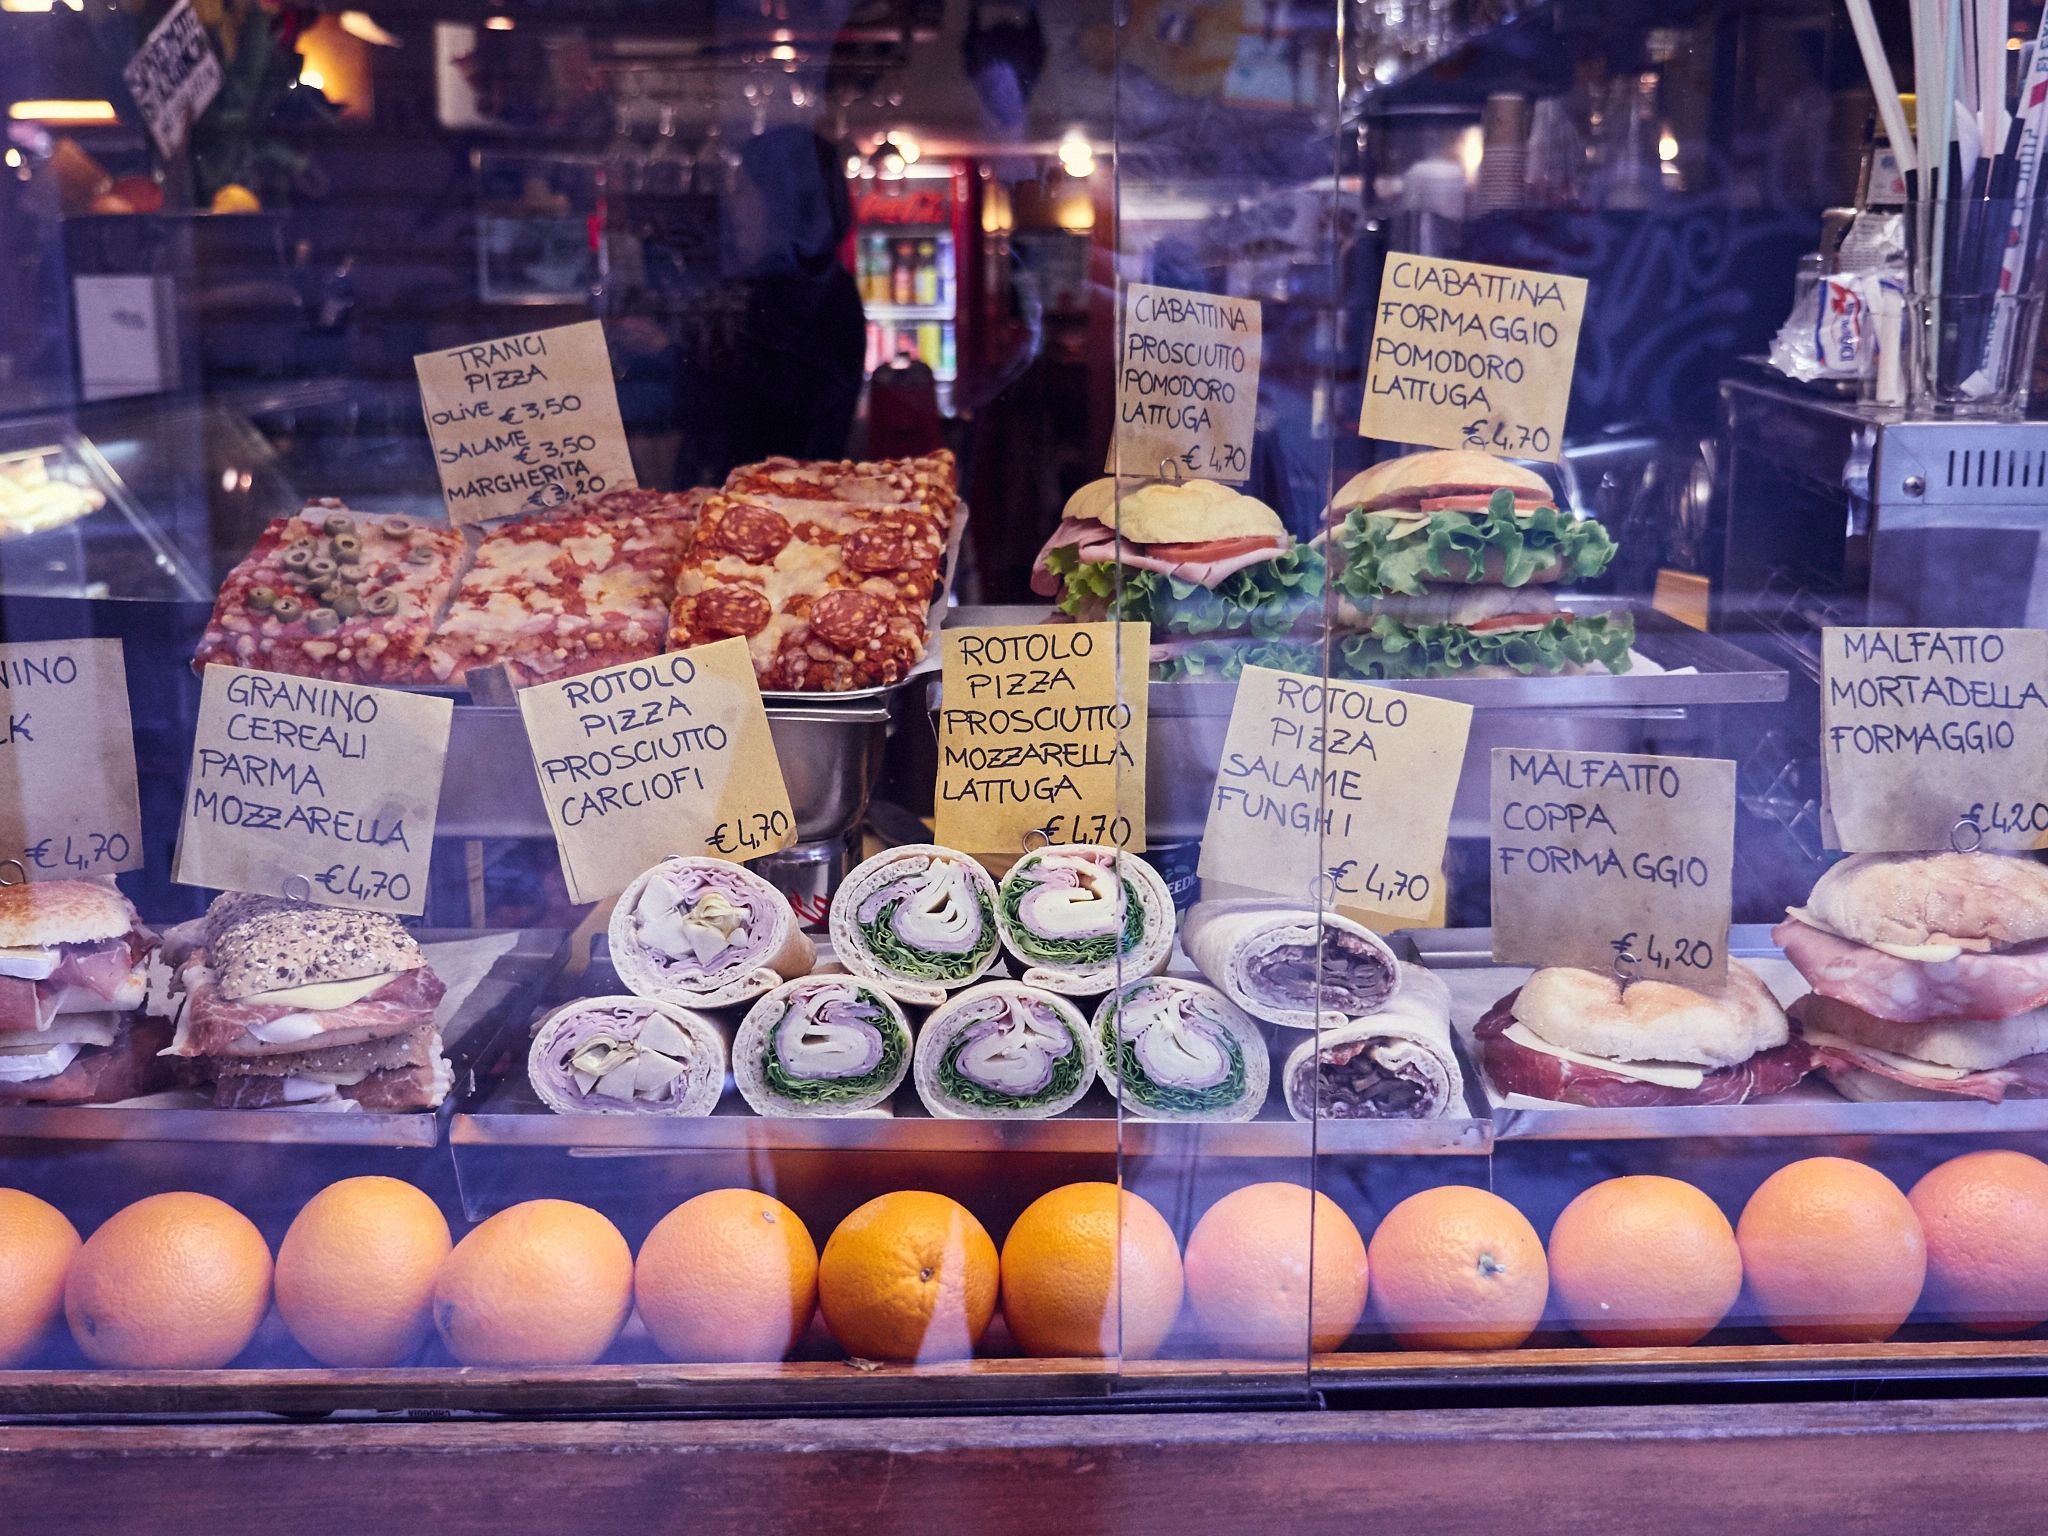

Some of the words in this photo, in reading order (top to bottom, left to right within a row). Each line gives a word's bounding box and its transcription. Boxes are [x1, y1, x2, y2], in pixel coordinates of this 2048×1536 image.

[1393, 262, 1565, 311] CIABATTINA
[1135, 295, 1248, 332] CIABATTINA
[1381, 302, 1558, 348] FORMAGGIO
[448, 336, 547, 371] TRANCI
[1129, 333, 1245, 373] PROSCIUTTO
[1376, 337, 1524, 384] POMODORO
[465, 364, 548, 392] PIZZA
[1125, 369, 1235, 404] POMODORO
[1372, 375, 1491, 412] LATTUGA
[1122, 402, 1211, 432] LATTUGA
[439, 430, 530, 464] SALAME
[447, 459, 590, 501] MARGHERITA
[958, 631, 1093, 666] ROTOLO
[1844, 632, 2004, 664] MALFATTO
[227, 674, 378, 723] GRANINO
[561, 656, 696, 708] ROTOLO
[966, 667, 1076, 699] PIZZA
[1278, 678, 1408, 727] ROTOLO
[1830, 676, 2048, 710] MORTADELLA
[227, 713, 367, 759] CEREALI
[579, 695, 692, 737] PIZZA
[943, 703, 1131, 735] PROSCIUTTO
[541, 724, 727, 784] PROSCIUTTO
[945, 740, 1135, 771] MOZZARELLA
[1270, 717, 1377, 762] PIZZA
[1830, 721, 2015, 755] FORMAGGIO
[198, 749, 325, 797] PARMA
[942, 774, 1083, 804] LATTUGA
[1222, 753, 1363, 801] SALAME
[1510, 753, 1680, 798] MALFATTO
[561, 766, 705, 826] CARCIOFI
[1217, 786, 1352, 837] FUNGHI
[193, 788, 409, 852] MOZZARELLA
[1503, 802, 1617, 835] COPPA
[1498, 846, 1708, 888] FORMAGGIO
